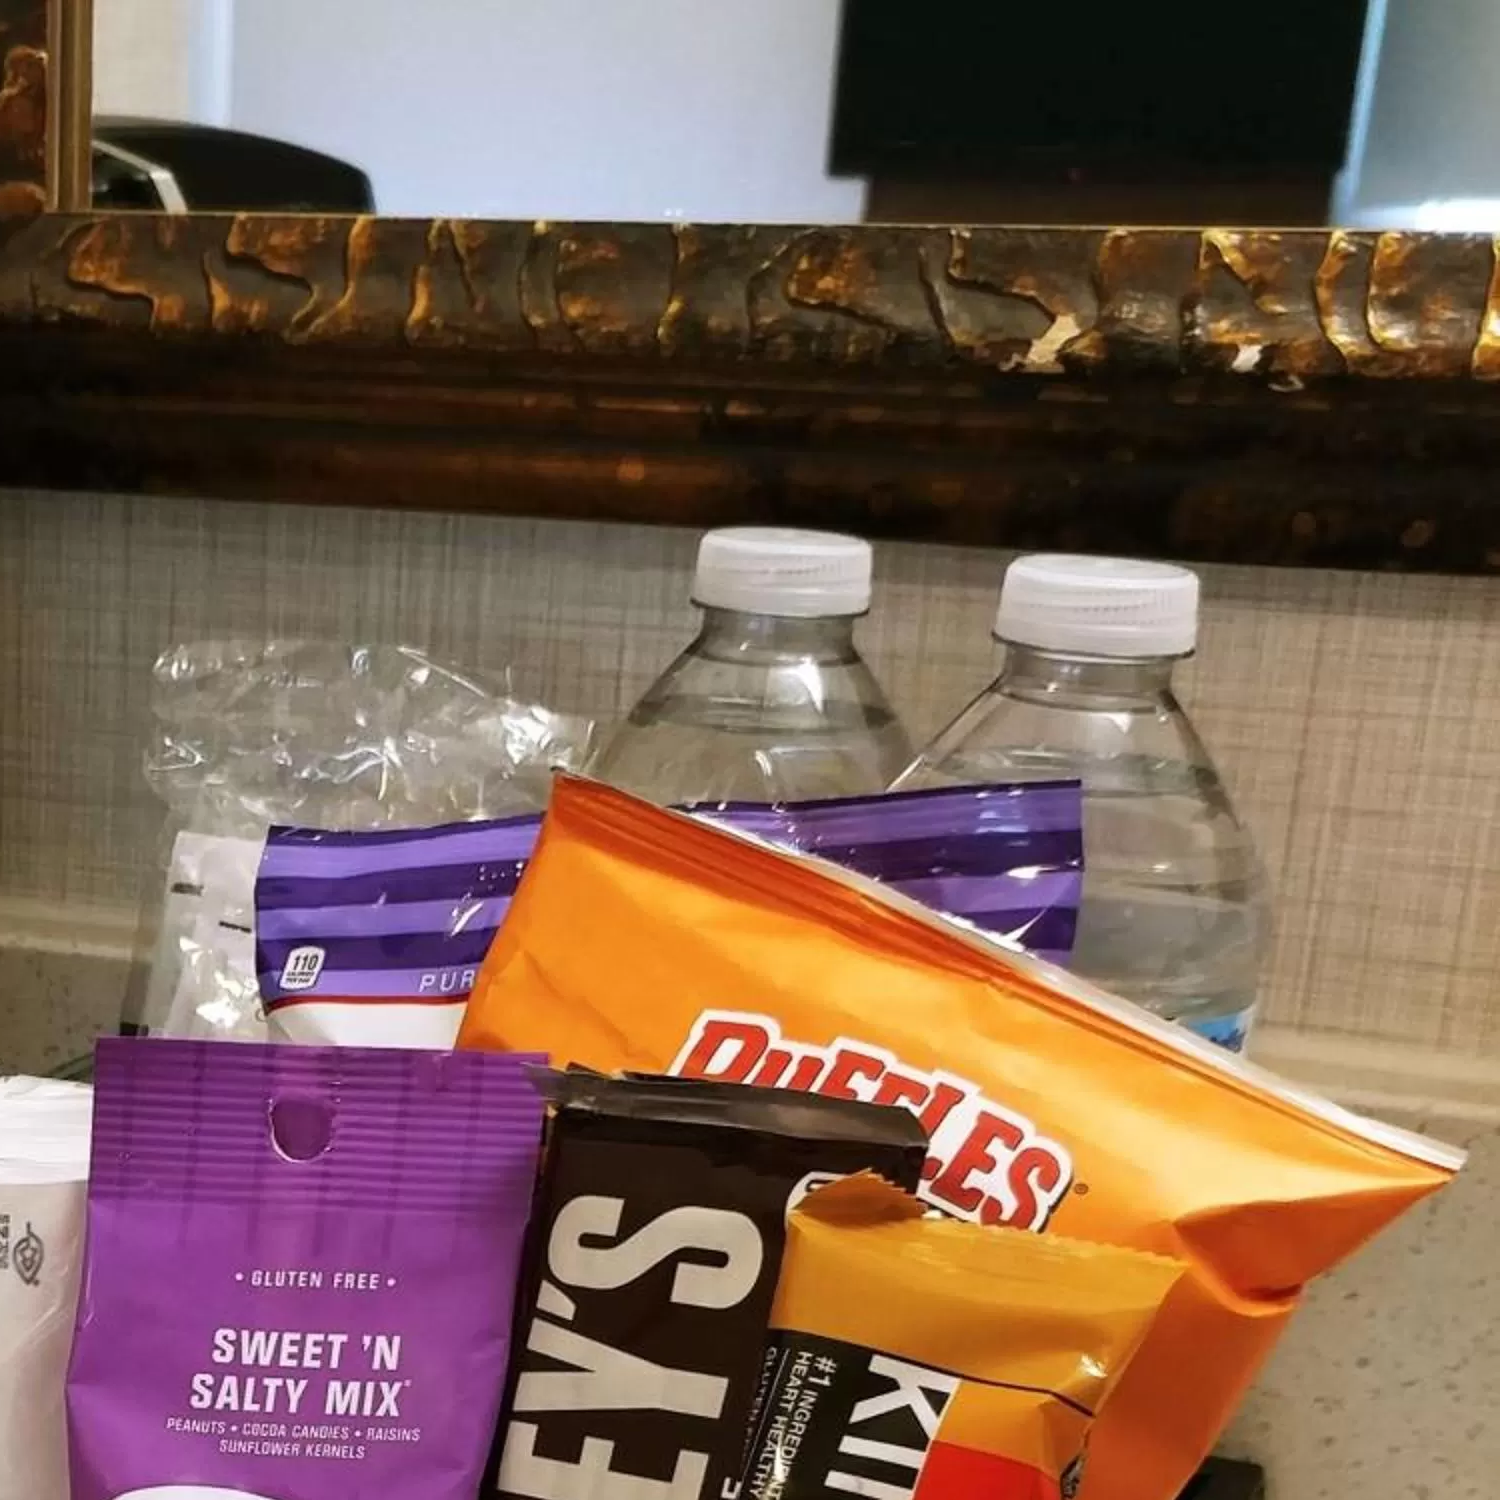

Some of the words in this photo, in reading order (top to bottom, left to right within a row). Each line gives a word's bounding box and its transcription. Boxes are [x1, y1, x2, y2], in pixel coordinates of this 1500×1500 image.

[292, 954, 319, 971] 110
[251, 1269, 323, 1289] GLUTEN
[333, 1271, 381, 1290] FREE
[211, 1327, 348, 1370] SWEET
[362, 1334, 401, 1371] 'N
[779, 1350, 814, 1413] HEART
[808, 1355, 838, 1387] #1
[189, 1372, 308, 1414] SALTY
[325, 1379, 403, 1418] MIX
[166, 1416, 226, 1435] PEANUTS
[242, 1421, 287, 1437] COCOA
[292, 1423, 350, 1440] CANDIES
[366, 1426, 421, 1442] RAISINS
[219, 1438, 300, 1457] SUNFLOWER
[305, 1442, 365, 1460] KERNELS
[748, 1414, 790, 1499] HEALTHY
